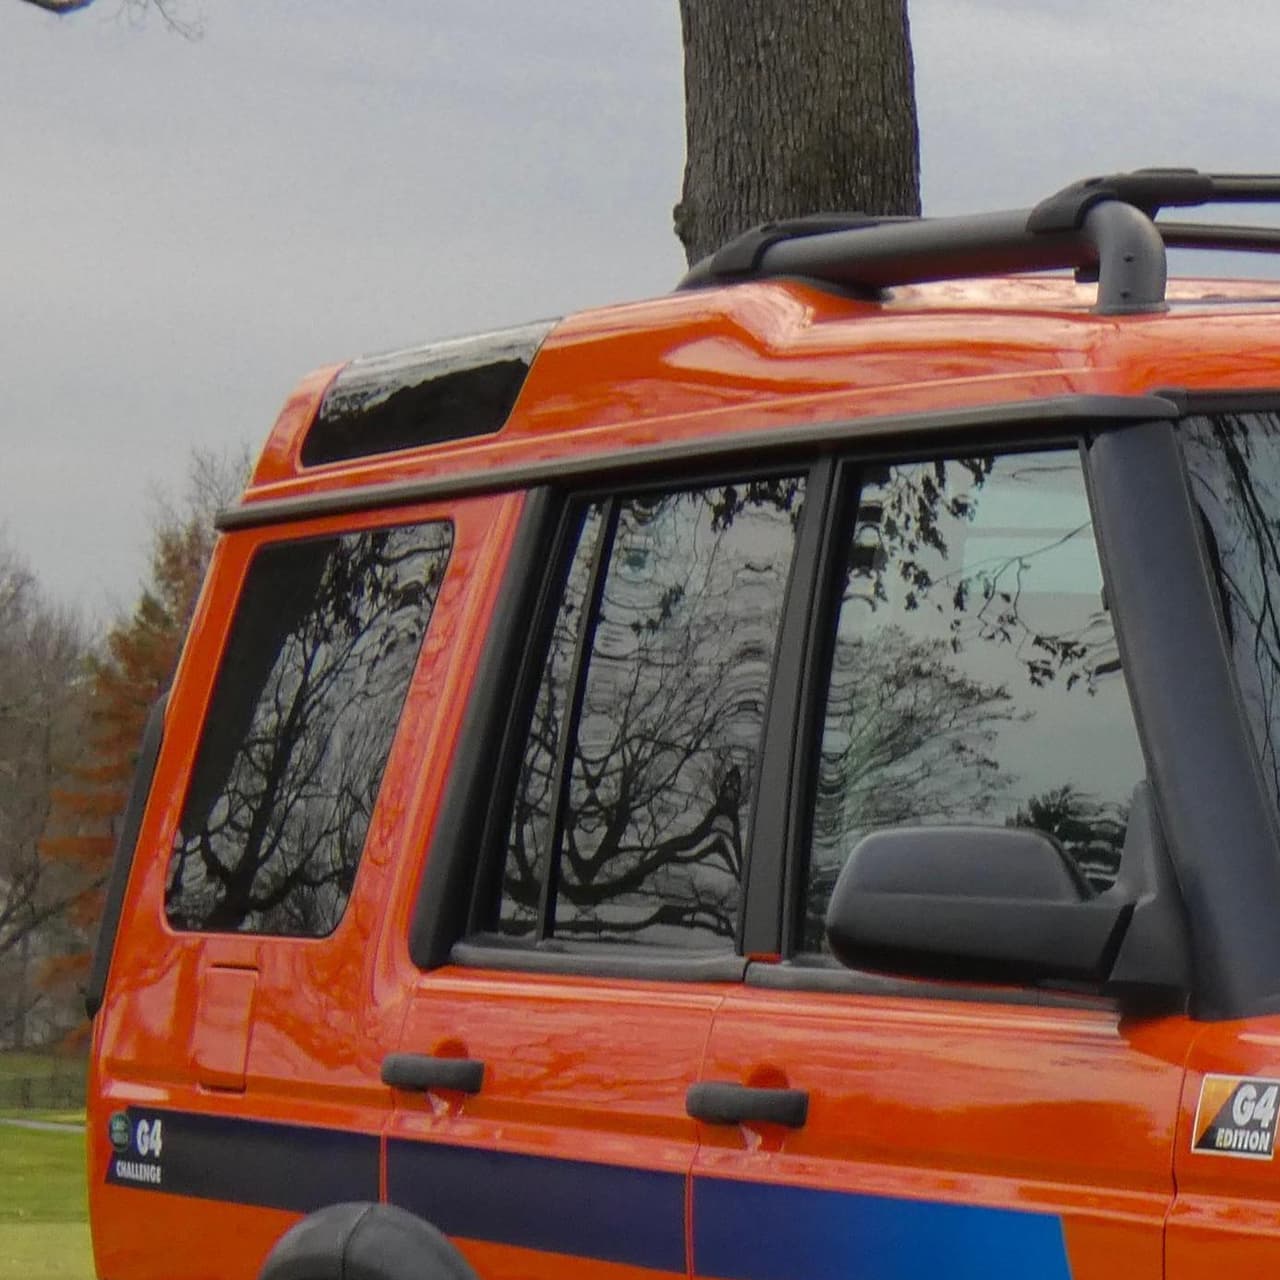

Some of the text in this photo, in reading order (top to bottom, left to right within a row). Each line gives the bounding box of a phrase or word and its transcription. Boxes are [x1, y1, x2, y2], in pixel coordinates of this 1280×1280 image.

[1233, 1085, 1278, 1127] G4
[137, 1119, 162, 1156] G4
[1216, 1128, 1270, 1151] EDITION
[116, 1161, 161, 1183] CHALLENGE
